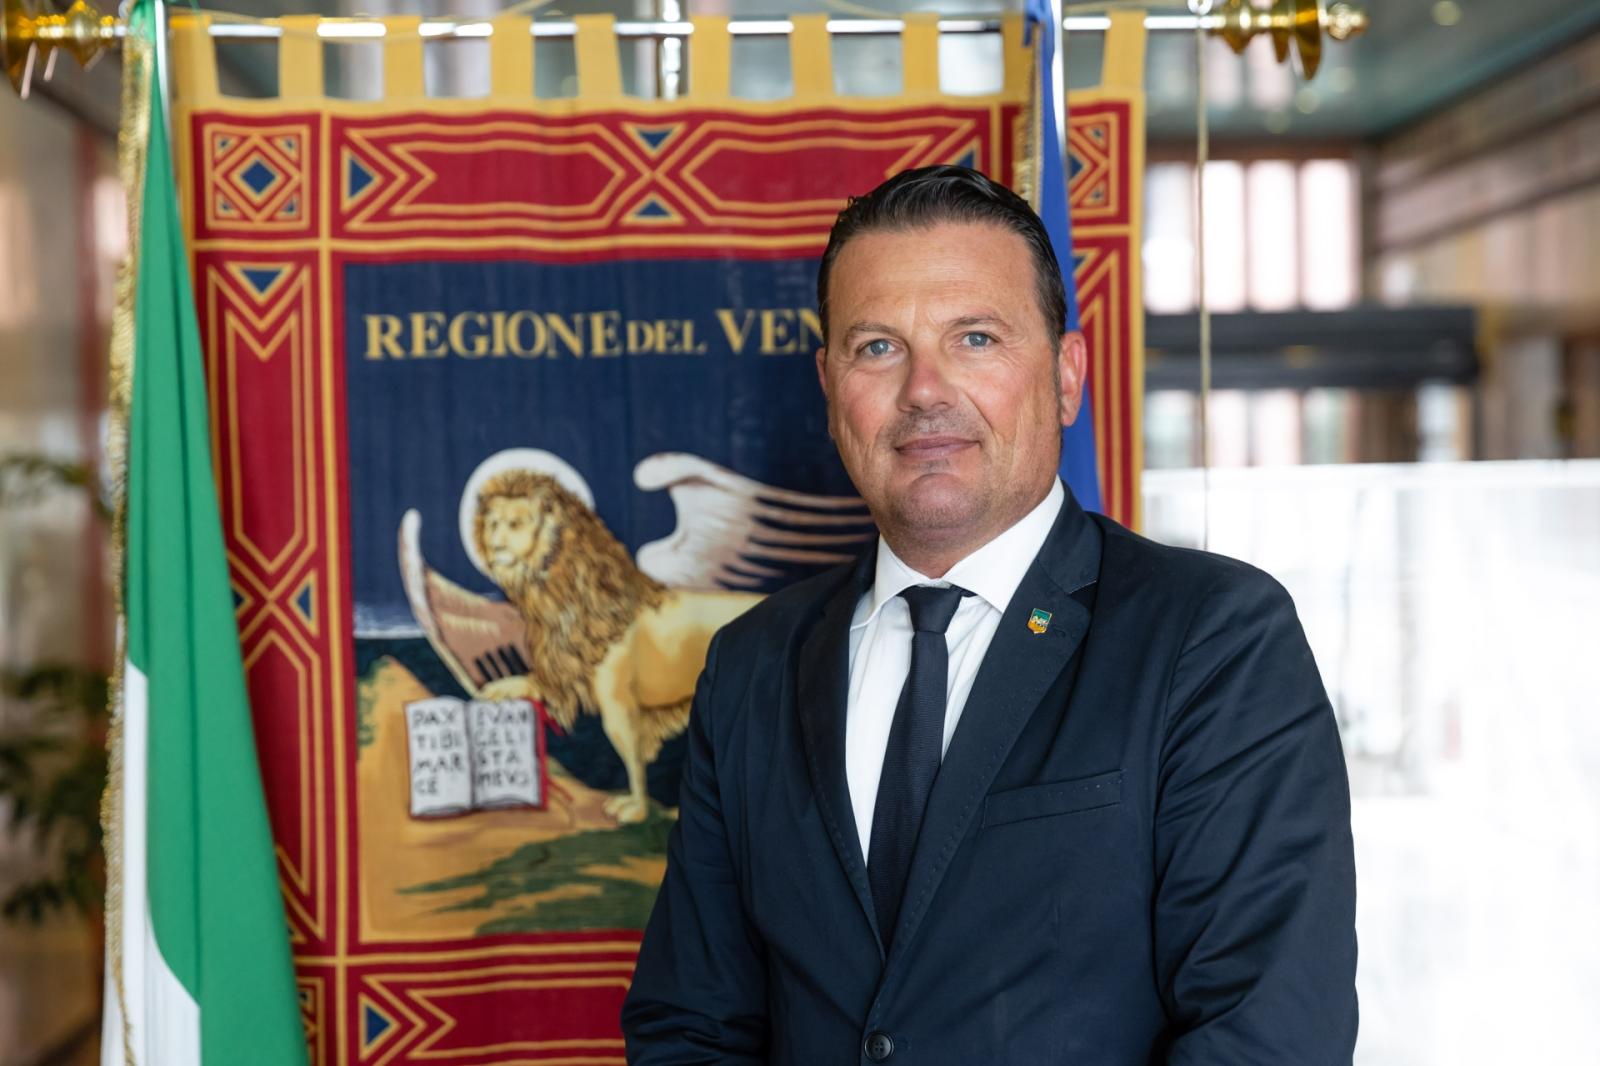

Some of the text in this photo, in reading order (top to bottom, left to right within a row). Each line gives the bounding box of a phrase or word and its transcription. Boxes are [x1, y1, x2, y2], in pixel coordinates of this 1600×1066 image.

[364, 310, 621, 359] REGIONE
[627, 319, 707, 355] DEL
[413, 706, 456, 727] PAX
[413, 754, 465, 772] MAR
